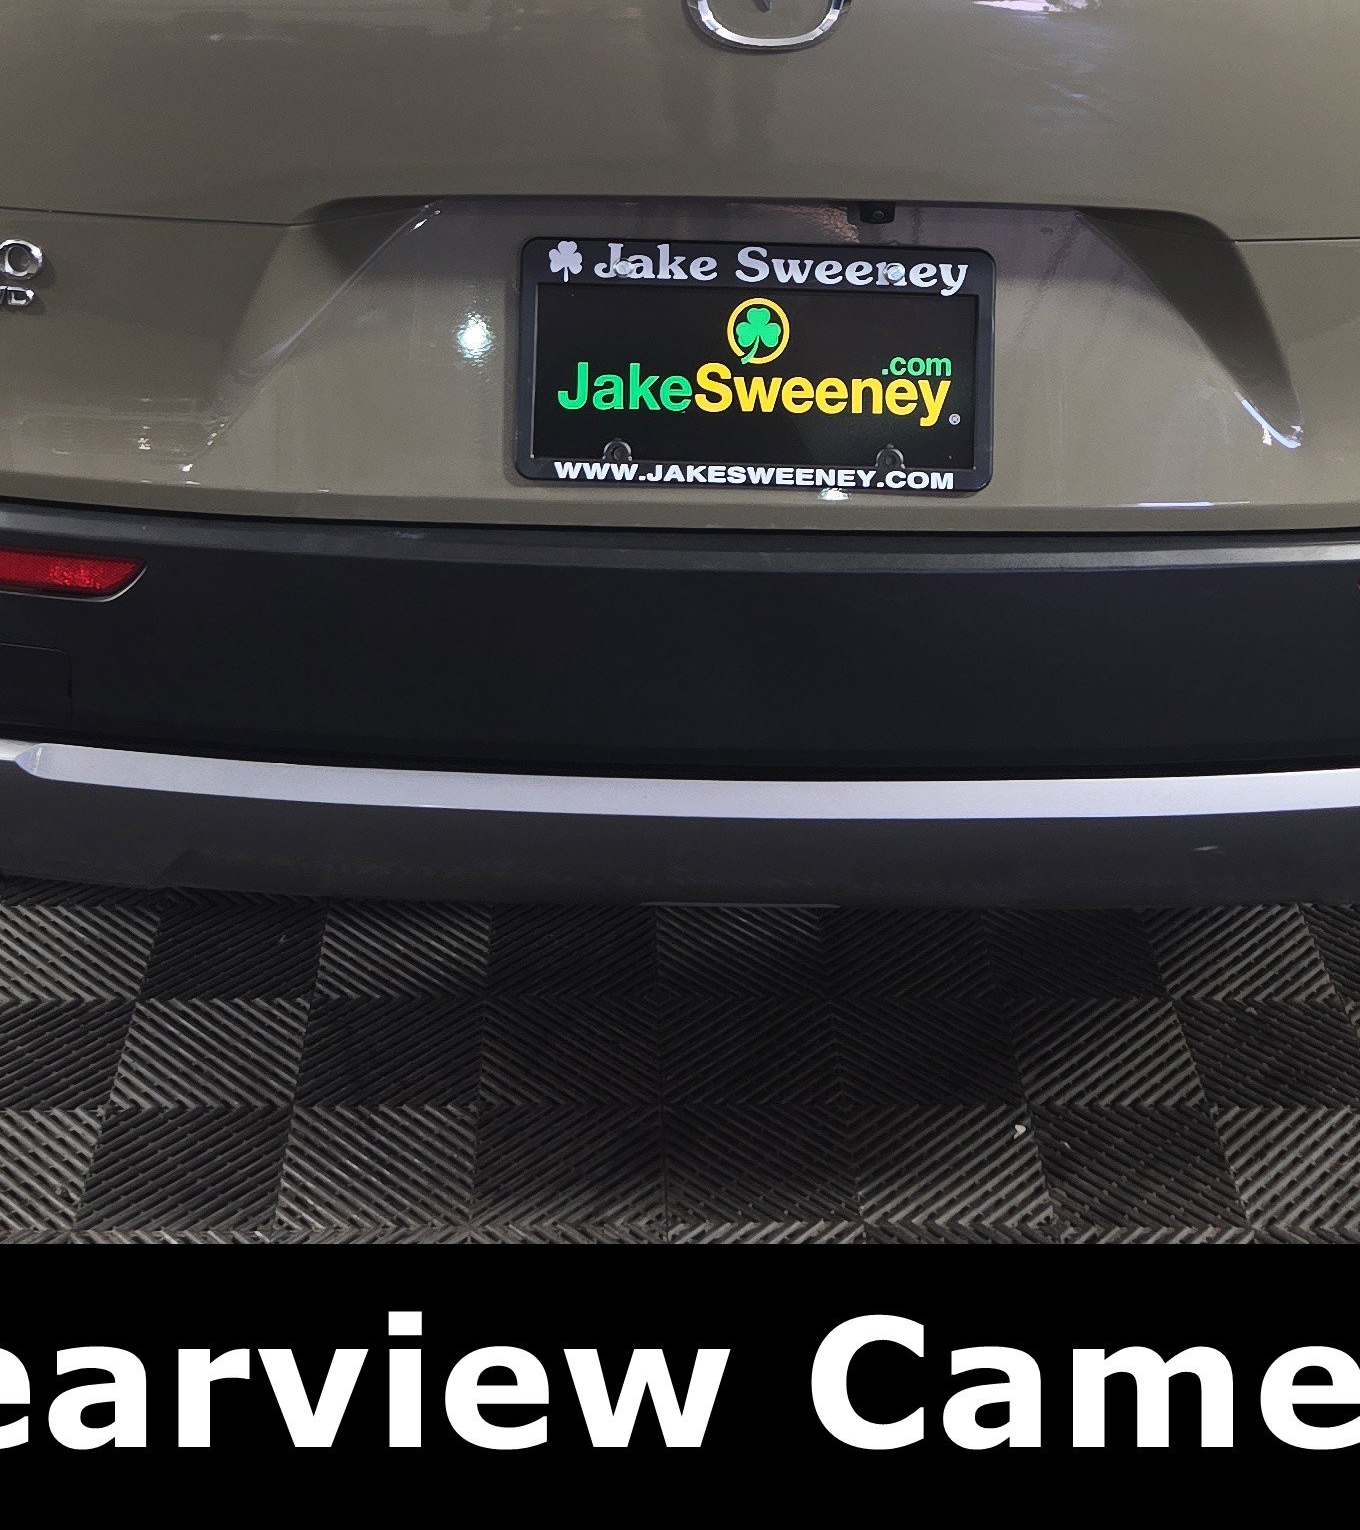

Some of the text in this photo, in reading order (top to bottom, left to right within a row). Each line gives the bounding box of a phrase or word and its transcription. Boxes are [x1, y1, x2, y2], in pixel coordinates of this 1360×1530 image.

[594, 243, 968, 297] Jake Sweeney
[881, 356, 952, 377] .com
[554, 461, 955, 491] WWW.JAKESWEENEY.COM
